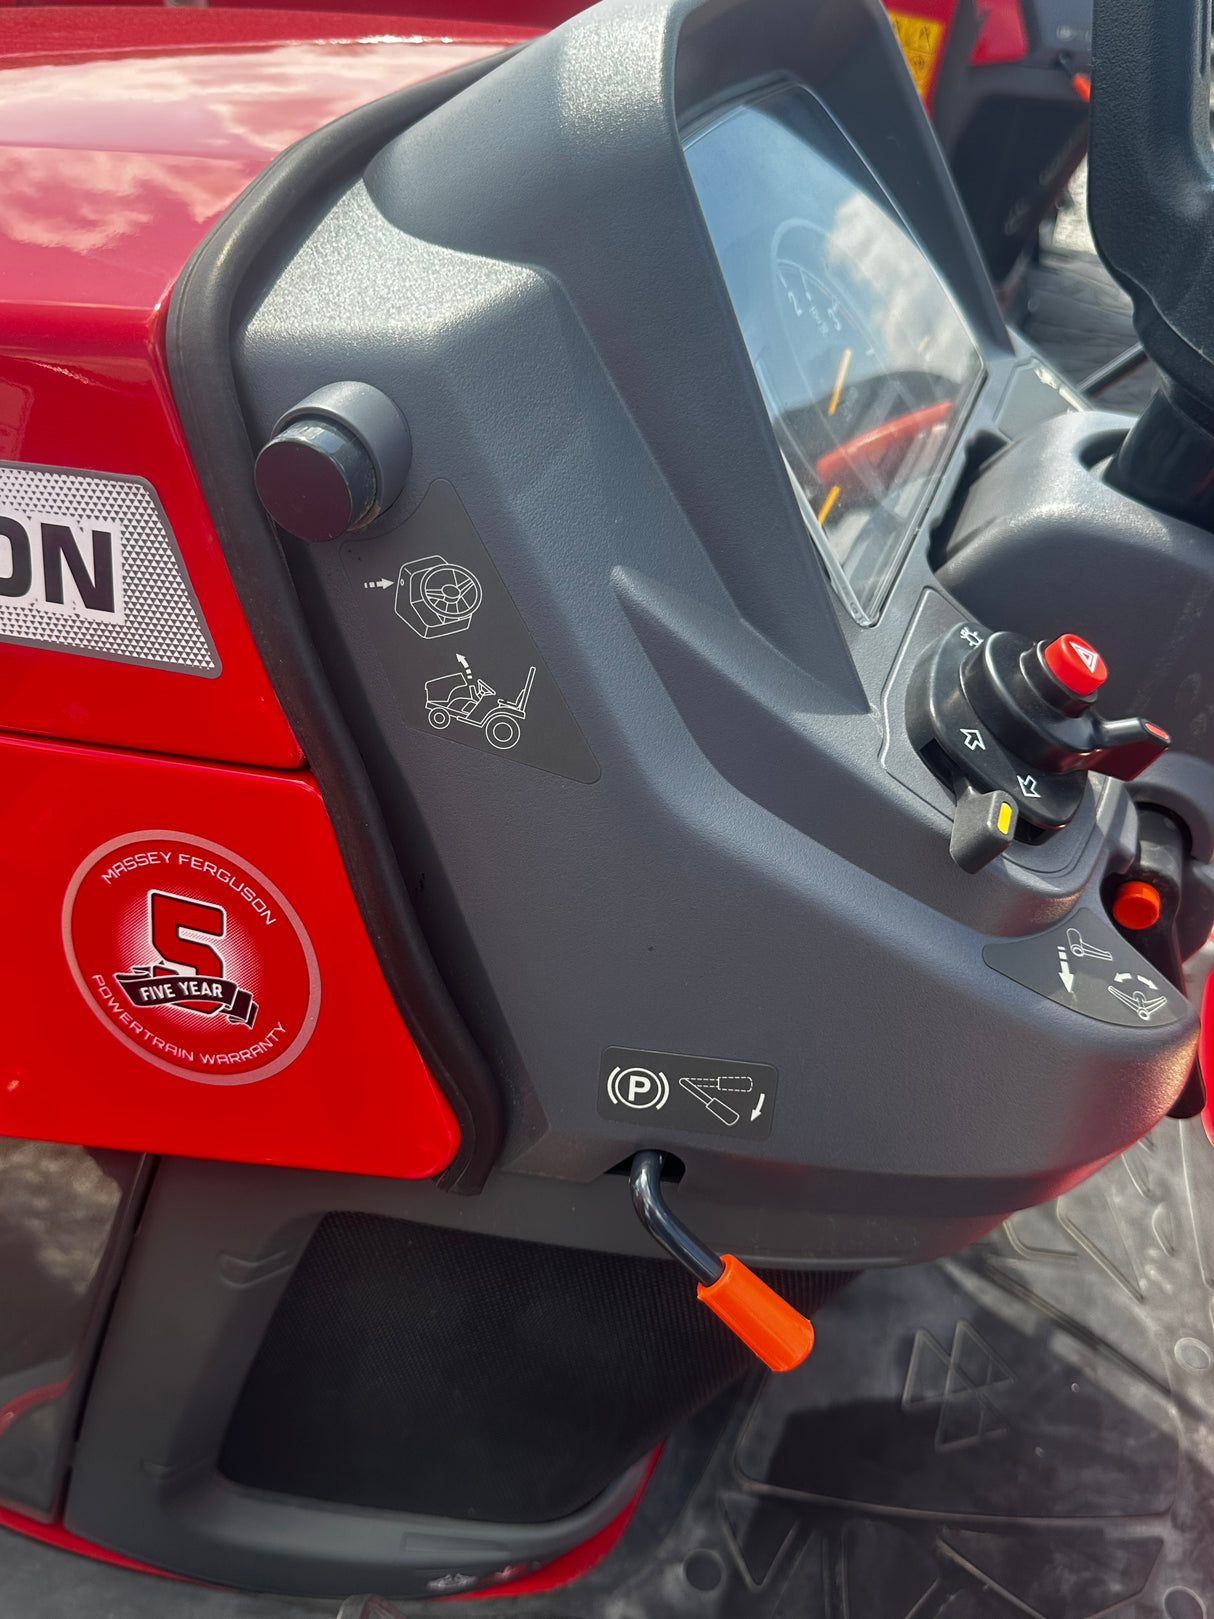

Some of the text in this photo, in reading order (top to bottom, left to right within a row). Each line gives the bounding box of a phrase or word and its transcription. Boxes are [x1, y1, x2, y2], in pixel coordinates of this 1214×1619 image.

[102, 852, 276, 925] MASSEY FERGUSON
[148, 889, 227, 1017] 5
[92, 974, 286, 1065] POWERTRAIN WARRANTY
[141, 981, 223, 1001] FIVE YEAR
[628, 1075, 651, 1101] P
